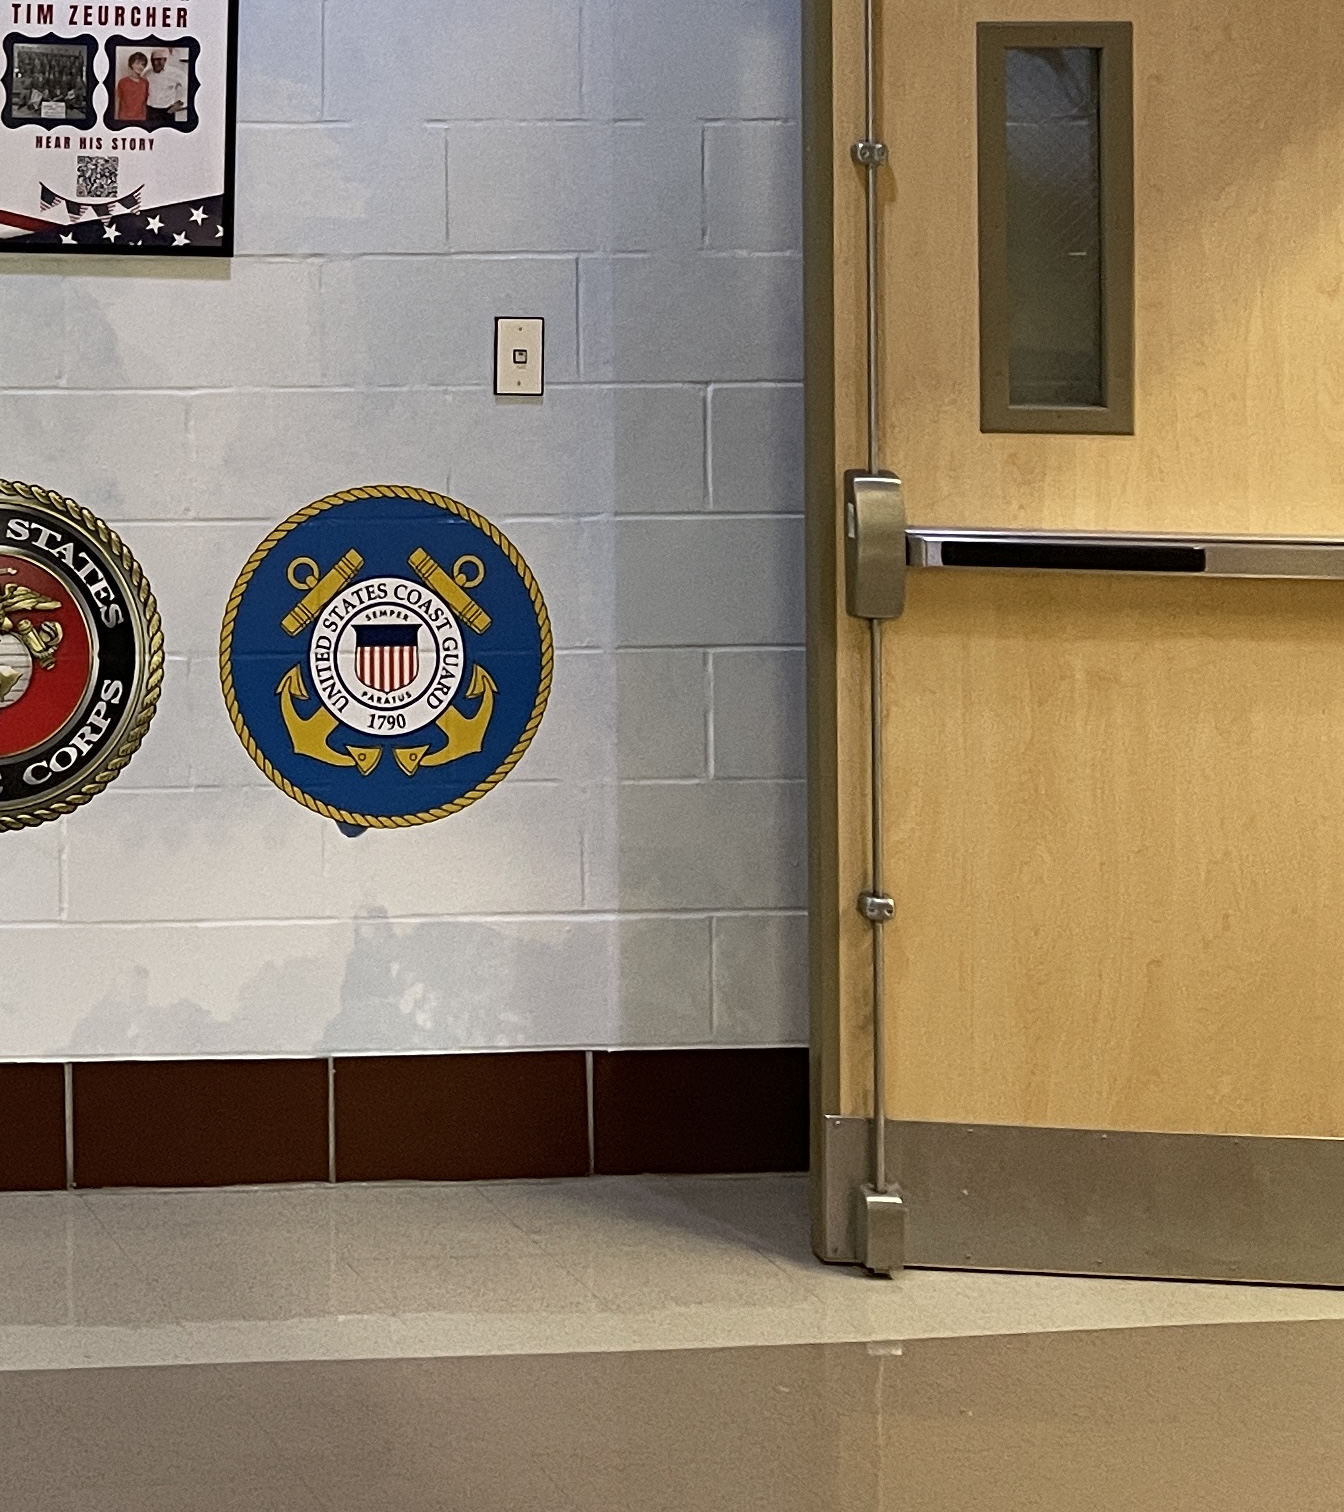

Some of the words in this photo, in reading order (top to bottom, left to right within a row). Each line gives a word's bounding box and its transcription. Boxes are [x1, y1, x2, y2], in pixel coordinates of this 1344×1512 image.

[12, 4, 53, 24] TIM
[69, 5, 187, 27] ZEURCHER
[36, 136, 70, 149] HEAR
[80, 137, 102, 149] HIS
[112, 138, 154, 150] STORY
[6, 518, 124, 628] STATES
[323, 583, 388, 632] STATES
[366, 610, 409, 621] SEMPER
[394, 584, 452, 631] COAST
[315, 636, 349, 713] UNITED
[427, 637, 459, 709] GUARD
[362, 691, 411, 704] PARATUS
[23, 679, 124, 786] CORPS
[368, 714, 406, 730] 1790
